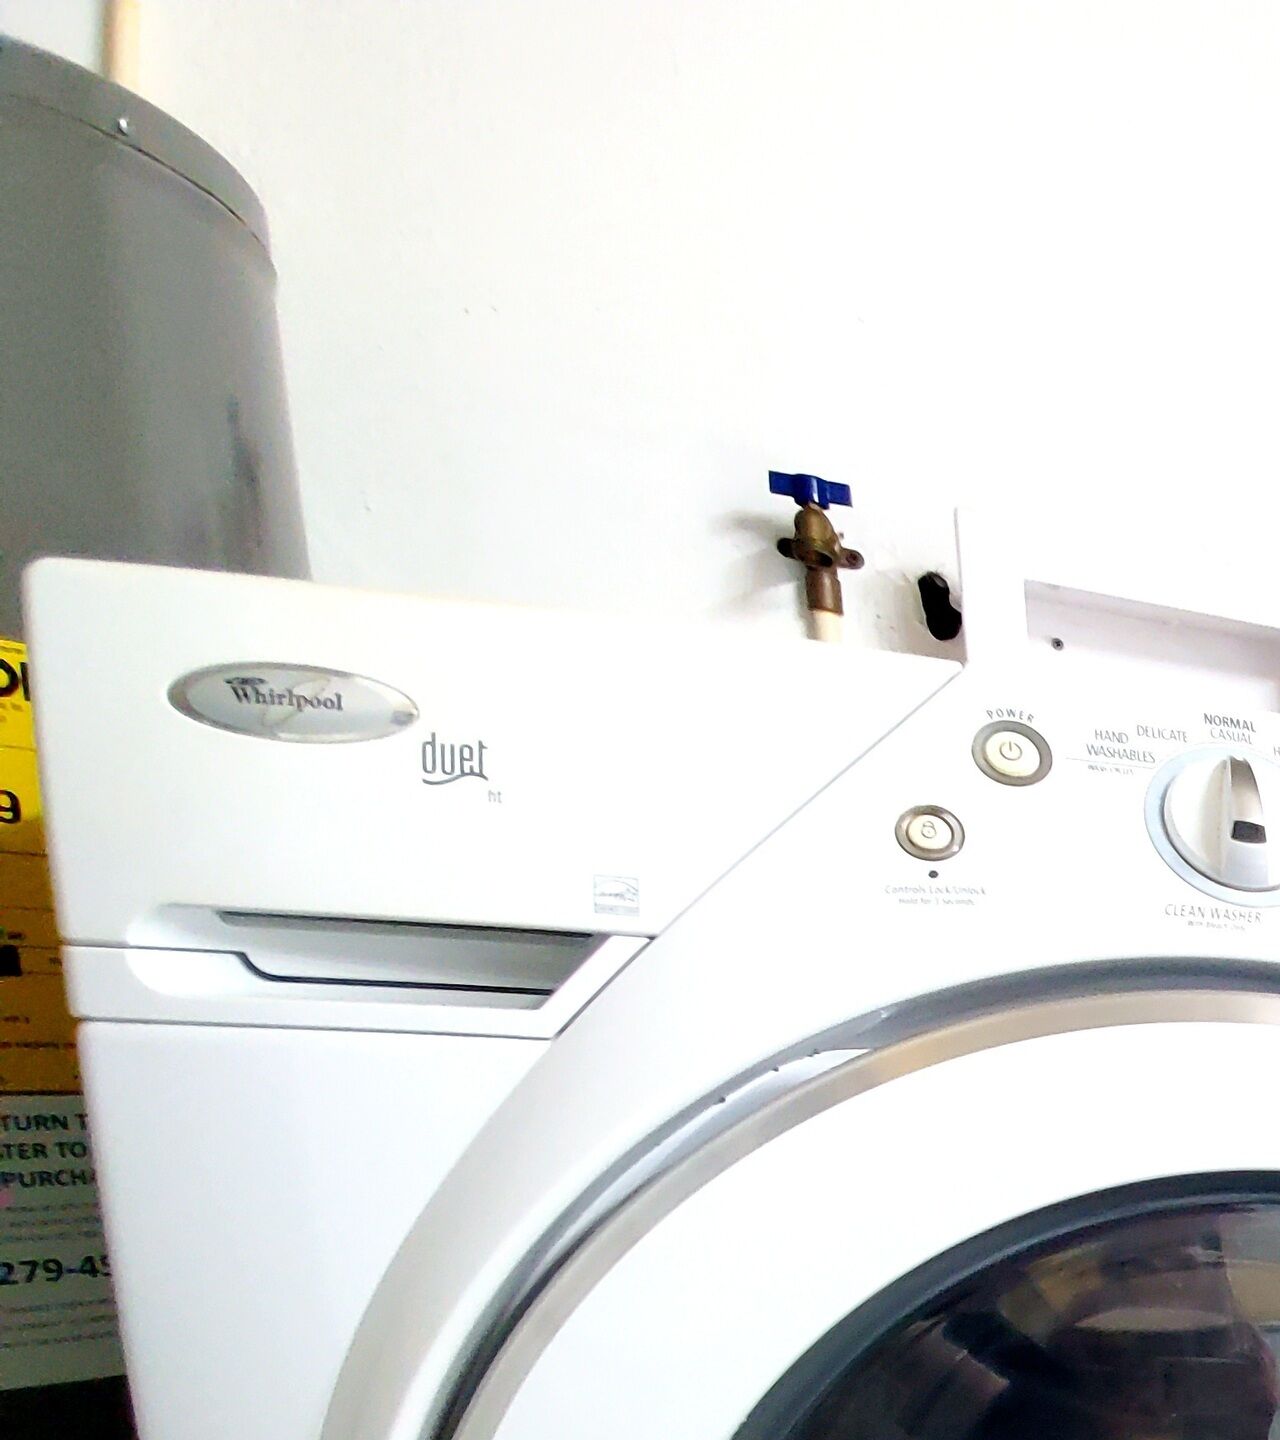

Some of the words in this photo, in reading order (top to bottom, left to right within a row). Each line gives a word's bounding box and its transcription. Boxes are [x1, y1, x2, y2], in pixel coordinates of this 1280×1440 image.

[229, 684, 344, 713] Whirlpool
[986, 708, 1035, 723] POWER
[1203, 712, 1257, 733] NORMAL
[1094, 728, 1129, 744] HAND
[1136, 724, 1188, 743] DELICATE
[1210, 727, 1253, 745] CASUAL
[421, 732, 488, 785] duet
[1086, 744, 1156, 764] WASHABLES
[1164, 903, 1205, 919] CLEAN
[1210, 906, 1262, 924] WASHER
[0, 1113, 68, 1132] TURN
[0, 1141, 48, 1160] TER
[54, 1140, 88, 1159] TO
